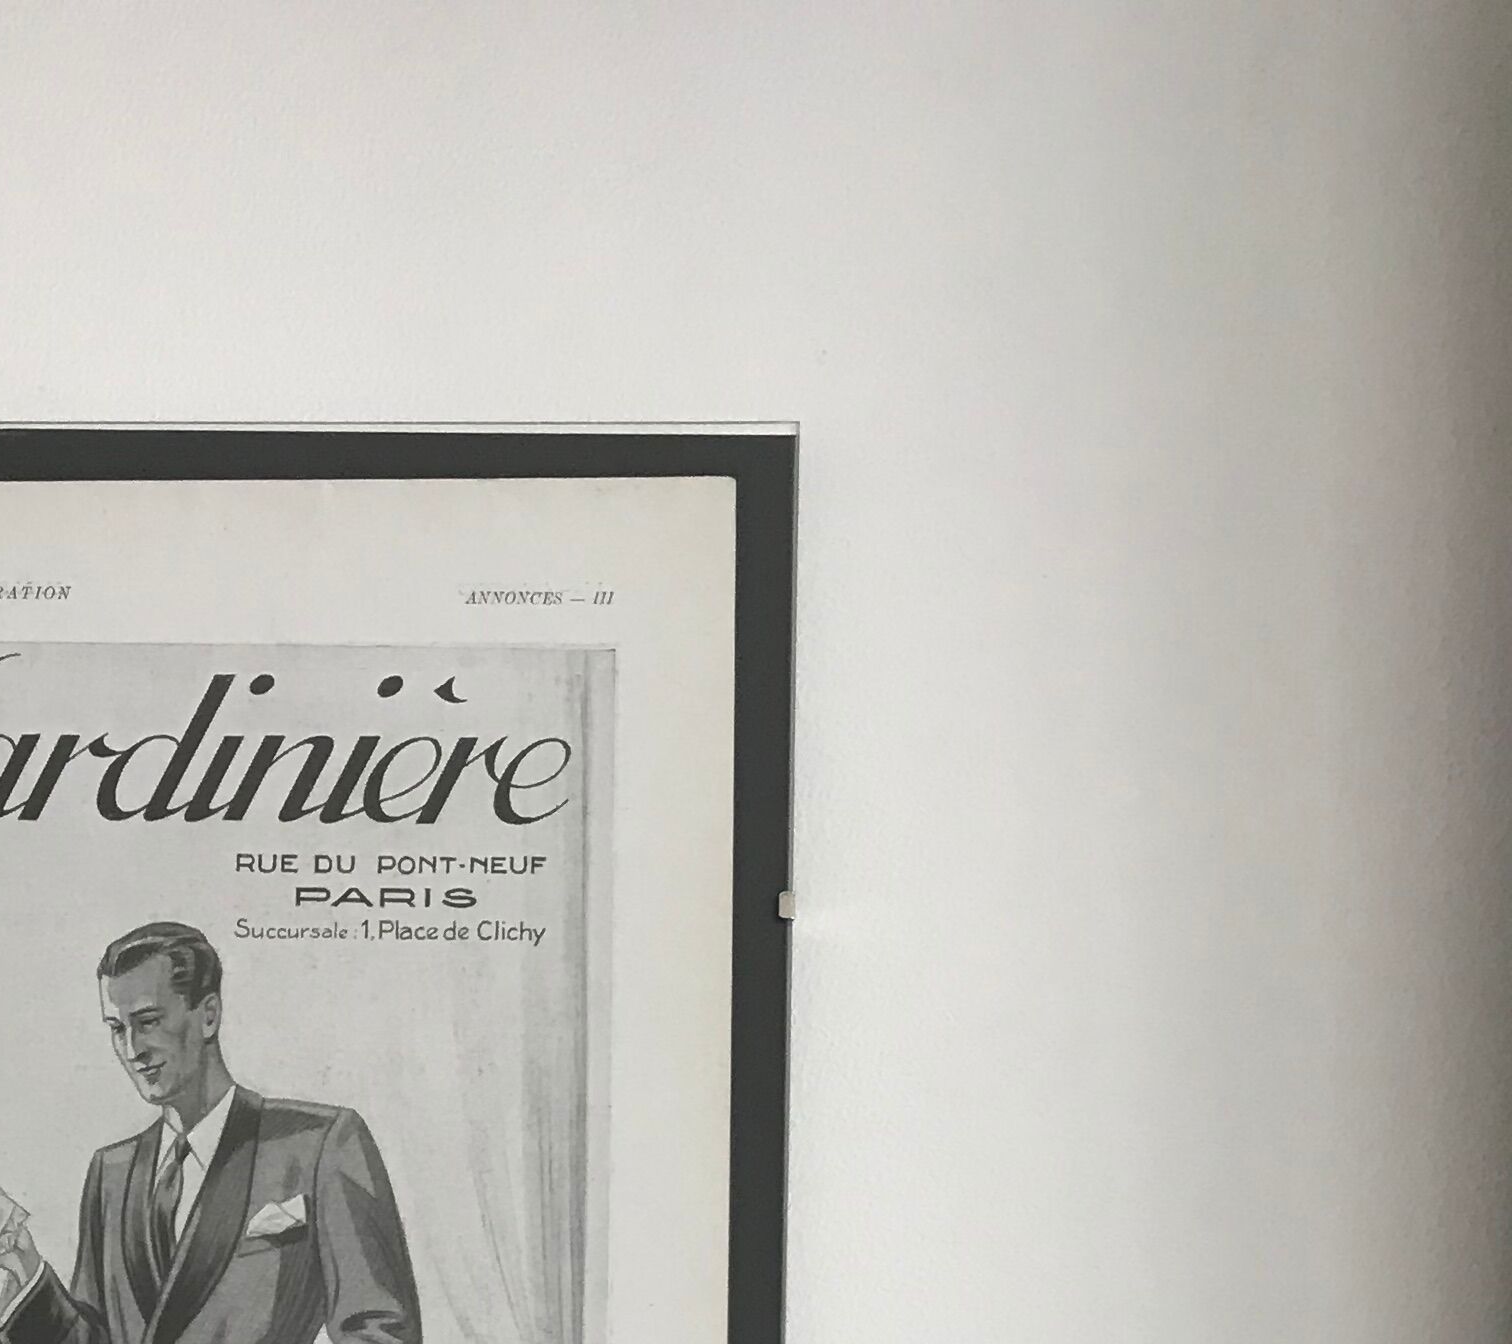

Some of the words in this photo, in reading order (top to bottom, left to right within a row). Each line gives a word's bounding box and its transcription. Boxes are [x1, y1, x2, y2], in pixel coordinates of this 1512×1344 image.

[465, 590, 562, 605] ANNONCES
[593, 591, 614, 605] III
[235, 853, 298, 873] RUE
[314, 855, 355, 874] DU
[377, 856, 546, 877] PONT-NEUF
[295, 887, 477, 908] PARIS
[378, 920, 439, 941] Place
[443, 921, 470, 941] de
[477, 920, 546, 947] Clichy
